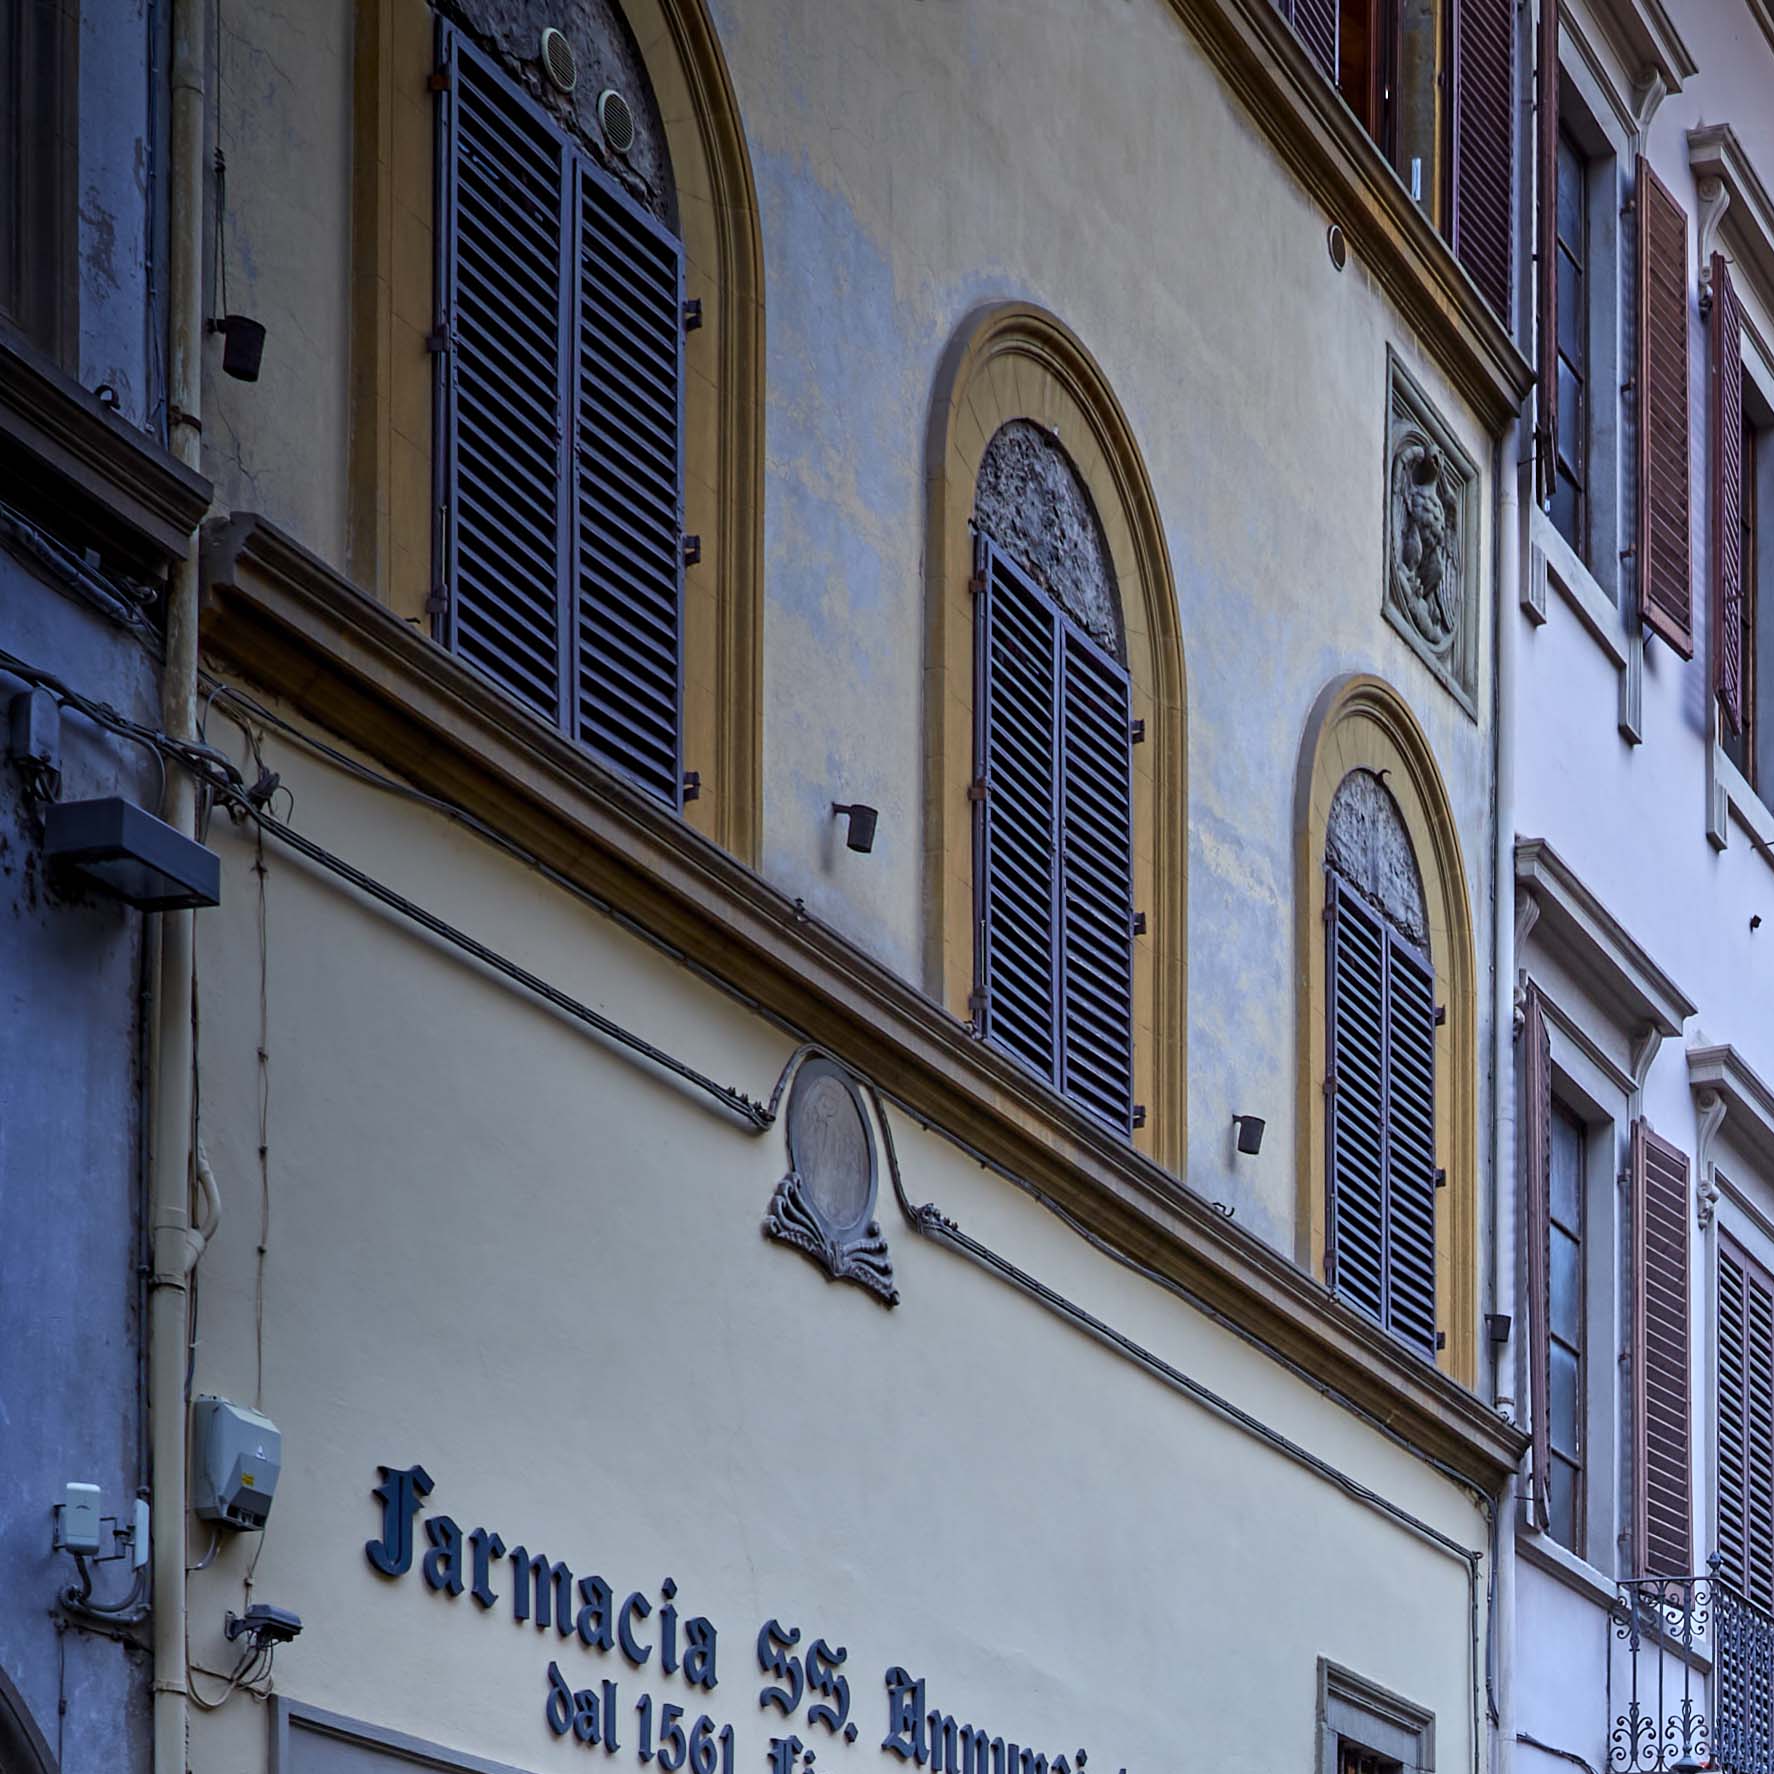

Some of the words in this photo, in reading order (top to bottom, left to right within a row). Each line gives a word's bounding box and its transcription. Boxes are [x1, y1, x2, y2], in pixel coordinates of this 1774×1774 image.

[365, 1465, 718, 1690] Farmacia
[757, 1619, 859, 1743] SS.
[546, 1662, 621, 1754] dal
